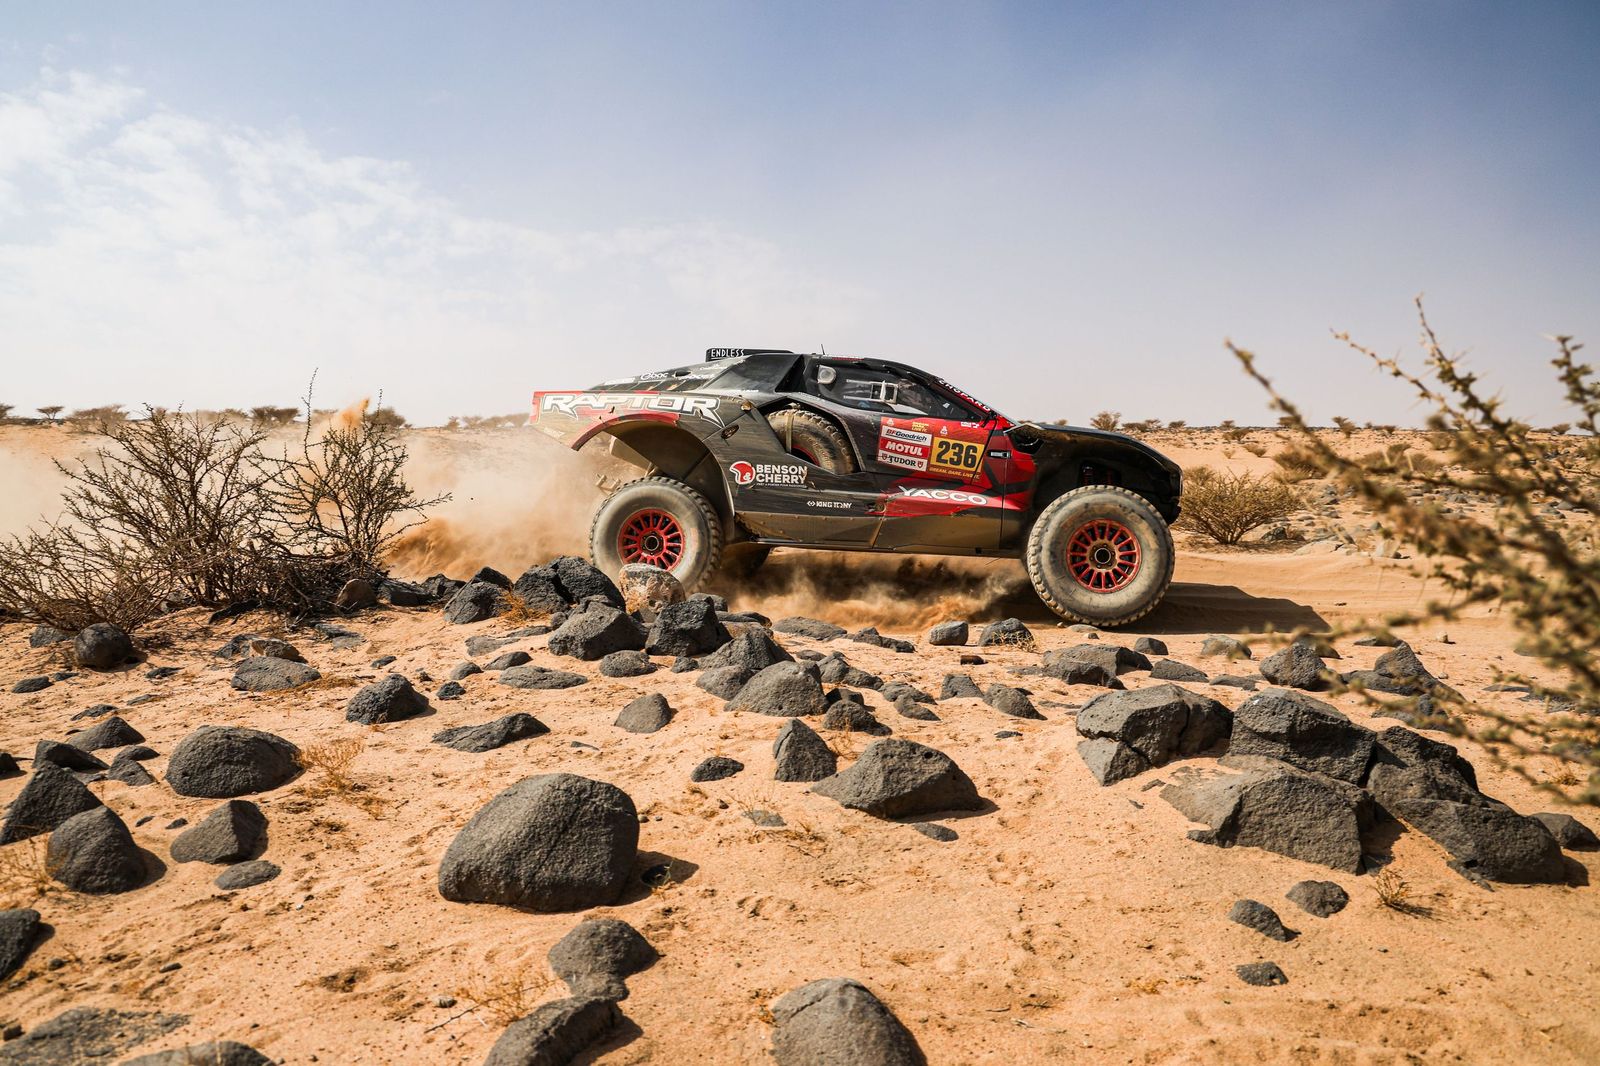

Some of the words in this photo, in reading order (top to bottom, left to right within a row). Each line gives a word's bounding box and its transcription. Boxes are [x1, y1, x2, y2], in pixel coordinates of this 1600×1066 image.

[711, 348, 744, 357] ENDLESS
[543, 393, 725, 428] RAPTOR
[886, 428, 927, 442] BFGoodrich
[885, 441, 923, 456] MOTUL
[936, 440, 978, 469] 236
[887, 455, 917, 467] TUDOR
[756, 464, 808, 475] BENSON
[756, 473, 807, 484] CHERRY
[898, 485, 987, 505] YACCO
[833, 501, 853, 509] TONY
